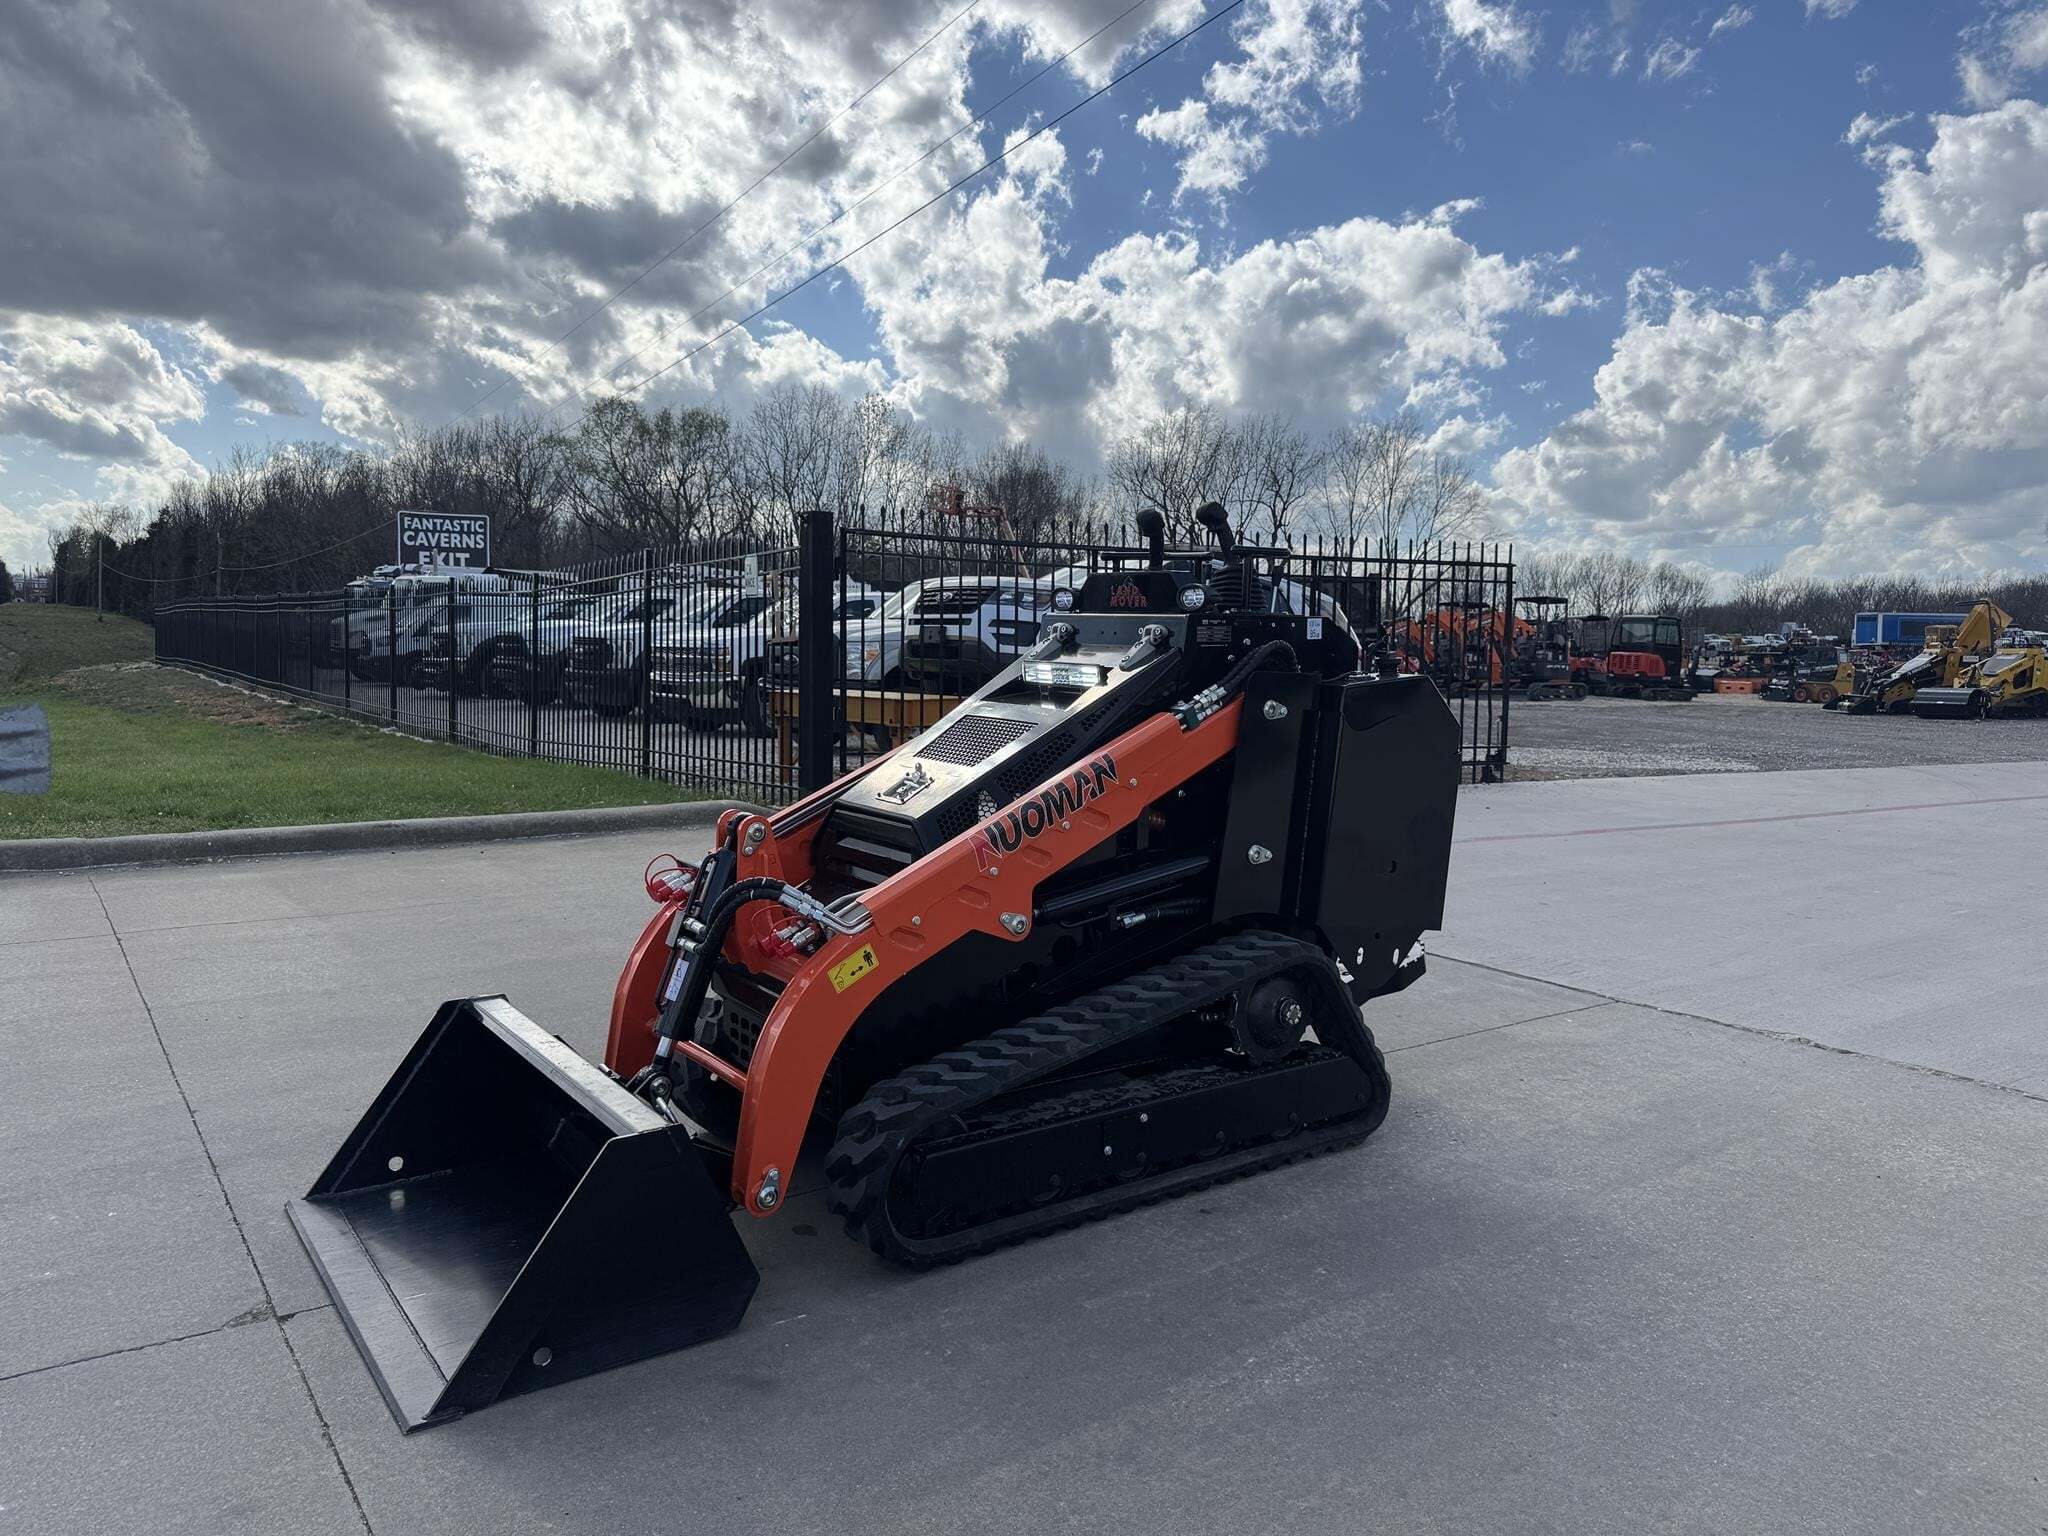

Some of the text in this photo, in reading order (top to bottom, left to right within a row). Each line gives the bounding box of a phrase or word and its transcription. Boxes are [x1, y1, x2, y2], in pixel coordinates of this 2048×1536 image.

[403, 517, 485, 533] FANTASTIC
[402, 531, 485, 549] CAVERNS
[418, 550, 470, 567] EXIT
[1110, 594, 1148, 608] MOVER
[968, 752, 1119, 873] NUOMAN
